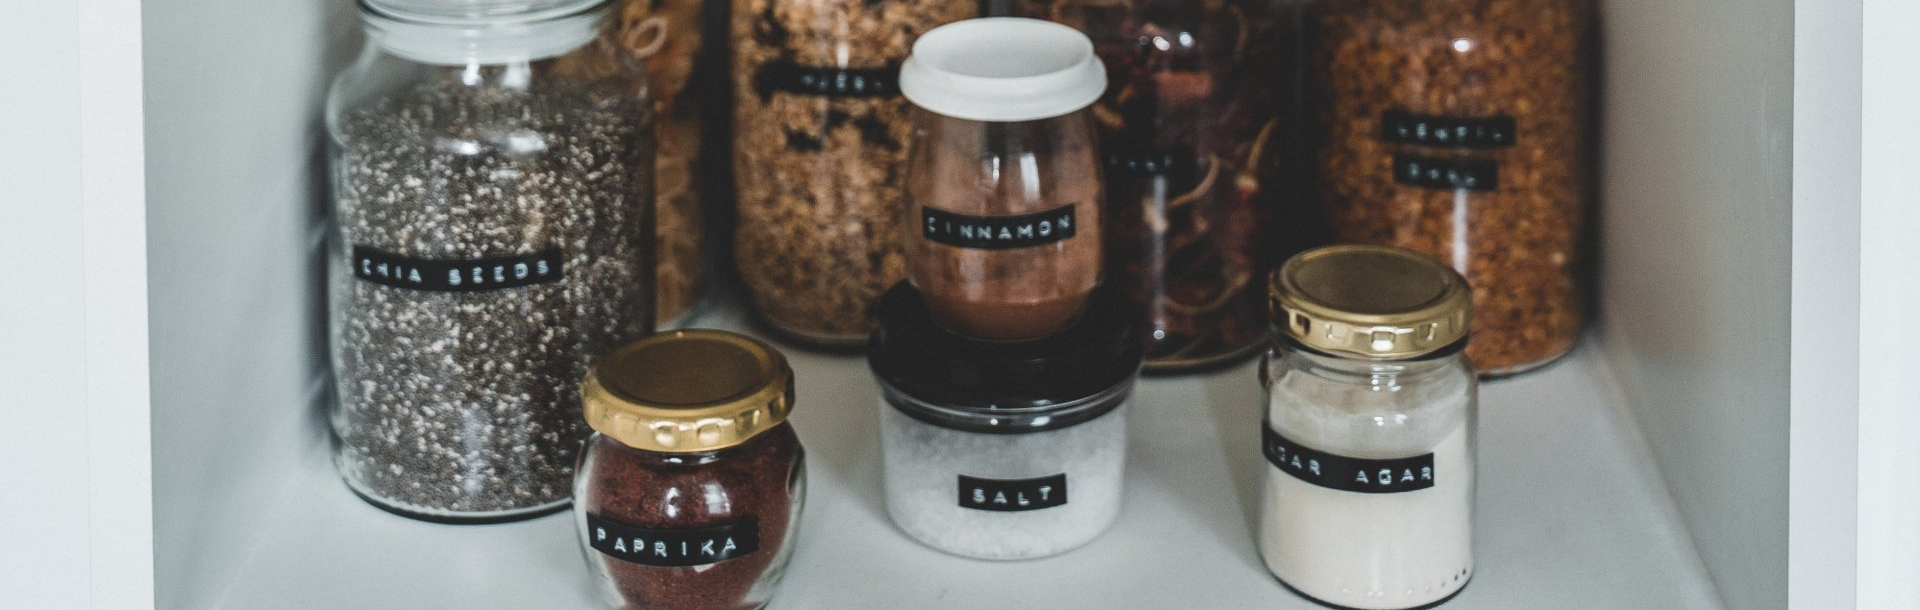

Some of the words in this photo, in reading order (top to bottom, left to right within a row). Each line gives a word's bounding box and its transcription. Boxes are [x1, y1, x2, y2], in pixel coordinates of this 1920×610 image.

[927, 214, 1070, 240] CINNAMON
[361, 258, 422, 284] CHIA
[448, 259, 550, 286] SEEDS
[1355, 466, 1433, 486] AGAR
[972, 485, 1053, 506] SALT
[596, 526, 737, 558] PAPRIKA
